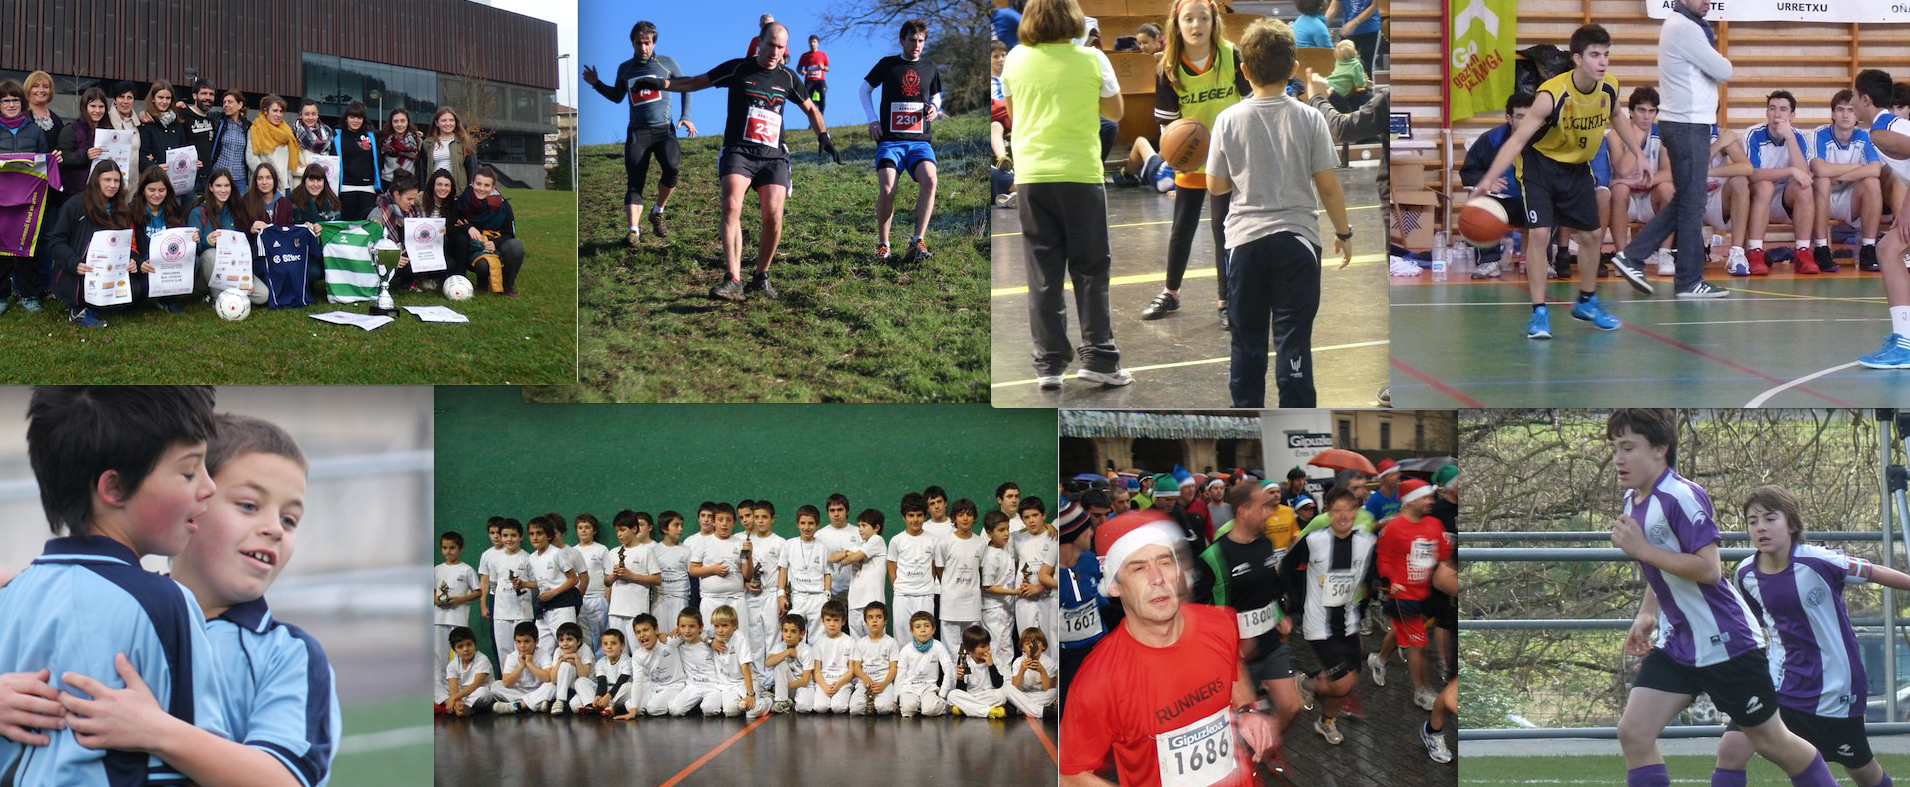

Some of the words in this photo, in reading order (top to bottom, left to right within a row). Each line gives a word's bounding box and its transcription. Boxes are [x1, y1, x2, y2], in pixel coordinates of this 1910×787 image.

[1776, 2, 1828, 13] URRETXU
[1190, 85, 1234, 104] LEGEA
[895, 114, 918, 125] 230
[1579, 136, 1588, 149] 9
[1529, 210, 1538, 223] 9
[1332, 583, 1351, 597] 504
[1066, 611, 1095, 632] 1607
[1244, 606, 1272, 628] 1800
[1171, 721, 1224, 747] Gipuzkoa
[1174, 731, 1229, 775] 1686
